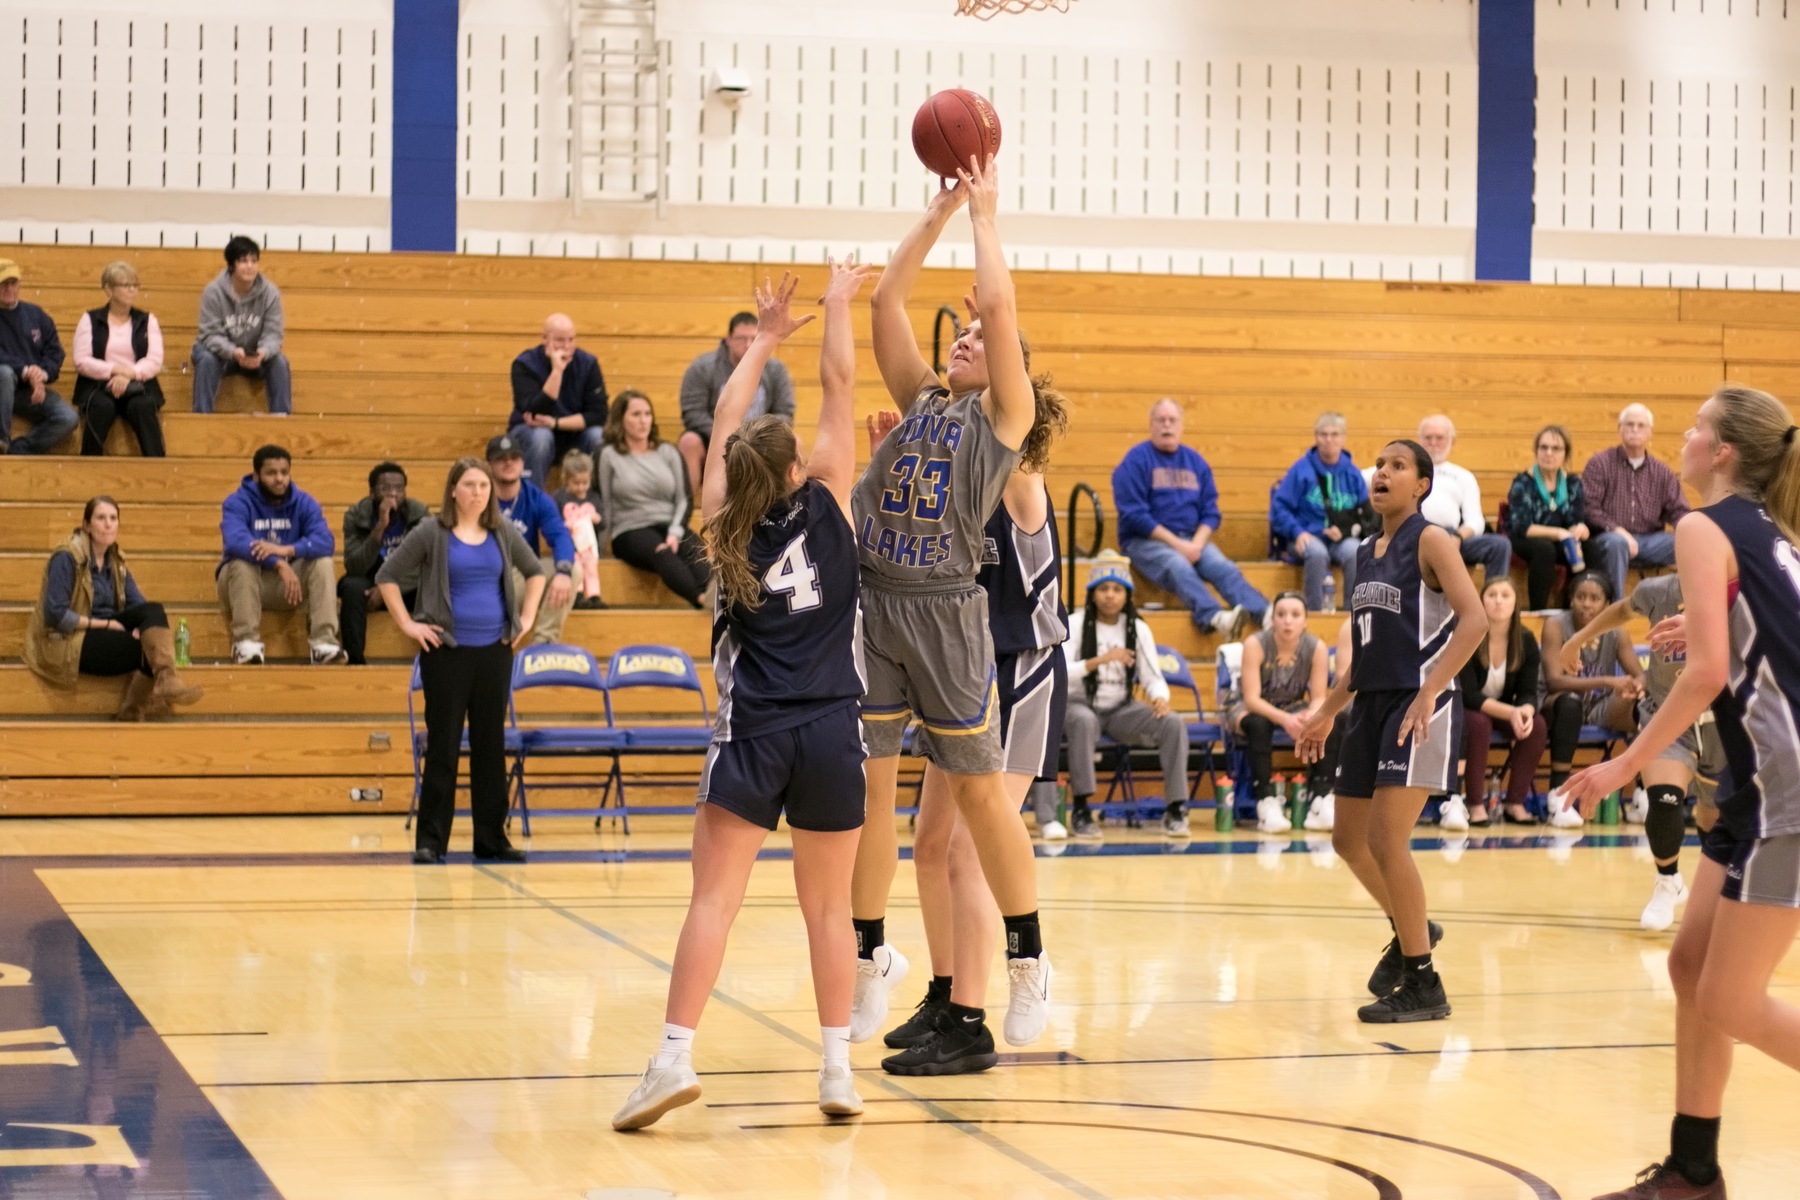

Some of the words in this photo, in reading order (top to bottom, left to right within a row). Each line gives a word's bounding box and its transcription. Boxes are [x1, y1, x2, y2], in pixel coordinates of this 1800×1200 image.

[879, 452, 951, 523] 33
[761, 528, 823, 615] 4
[861, 513, 955, 569] LAKES
[1357, 611, 1373, 648] 10
